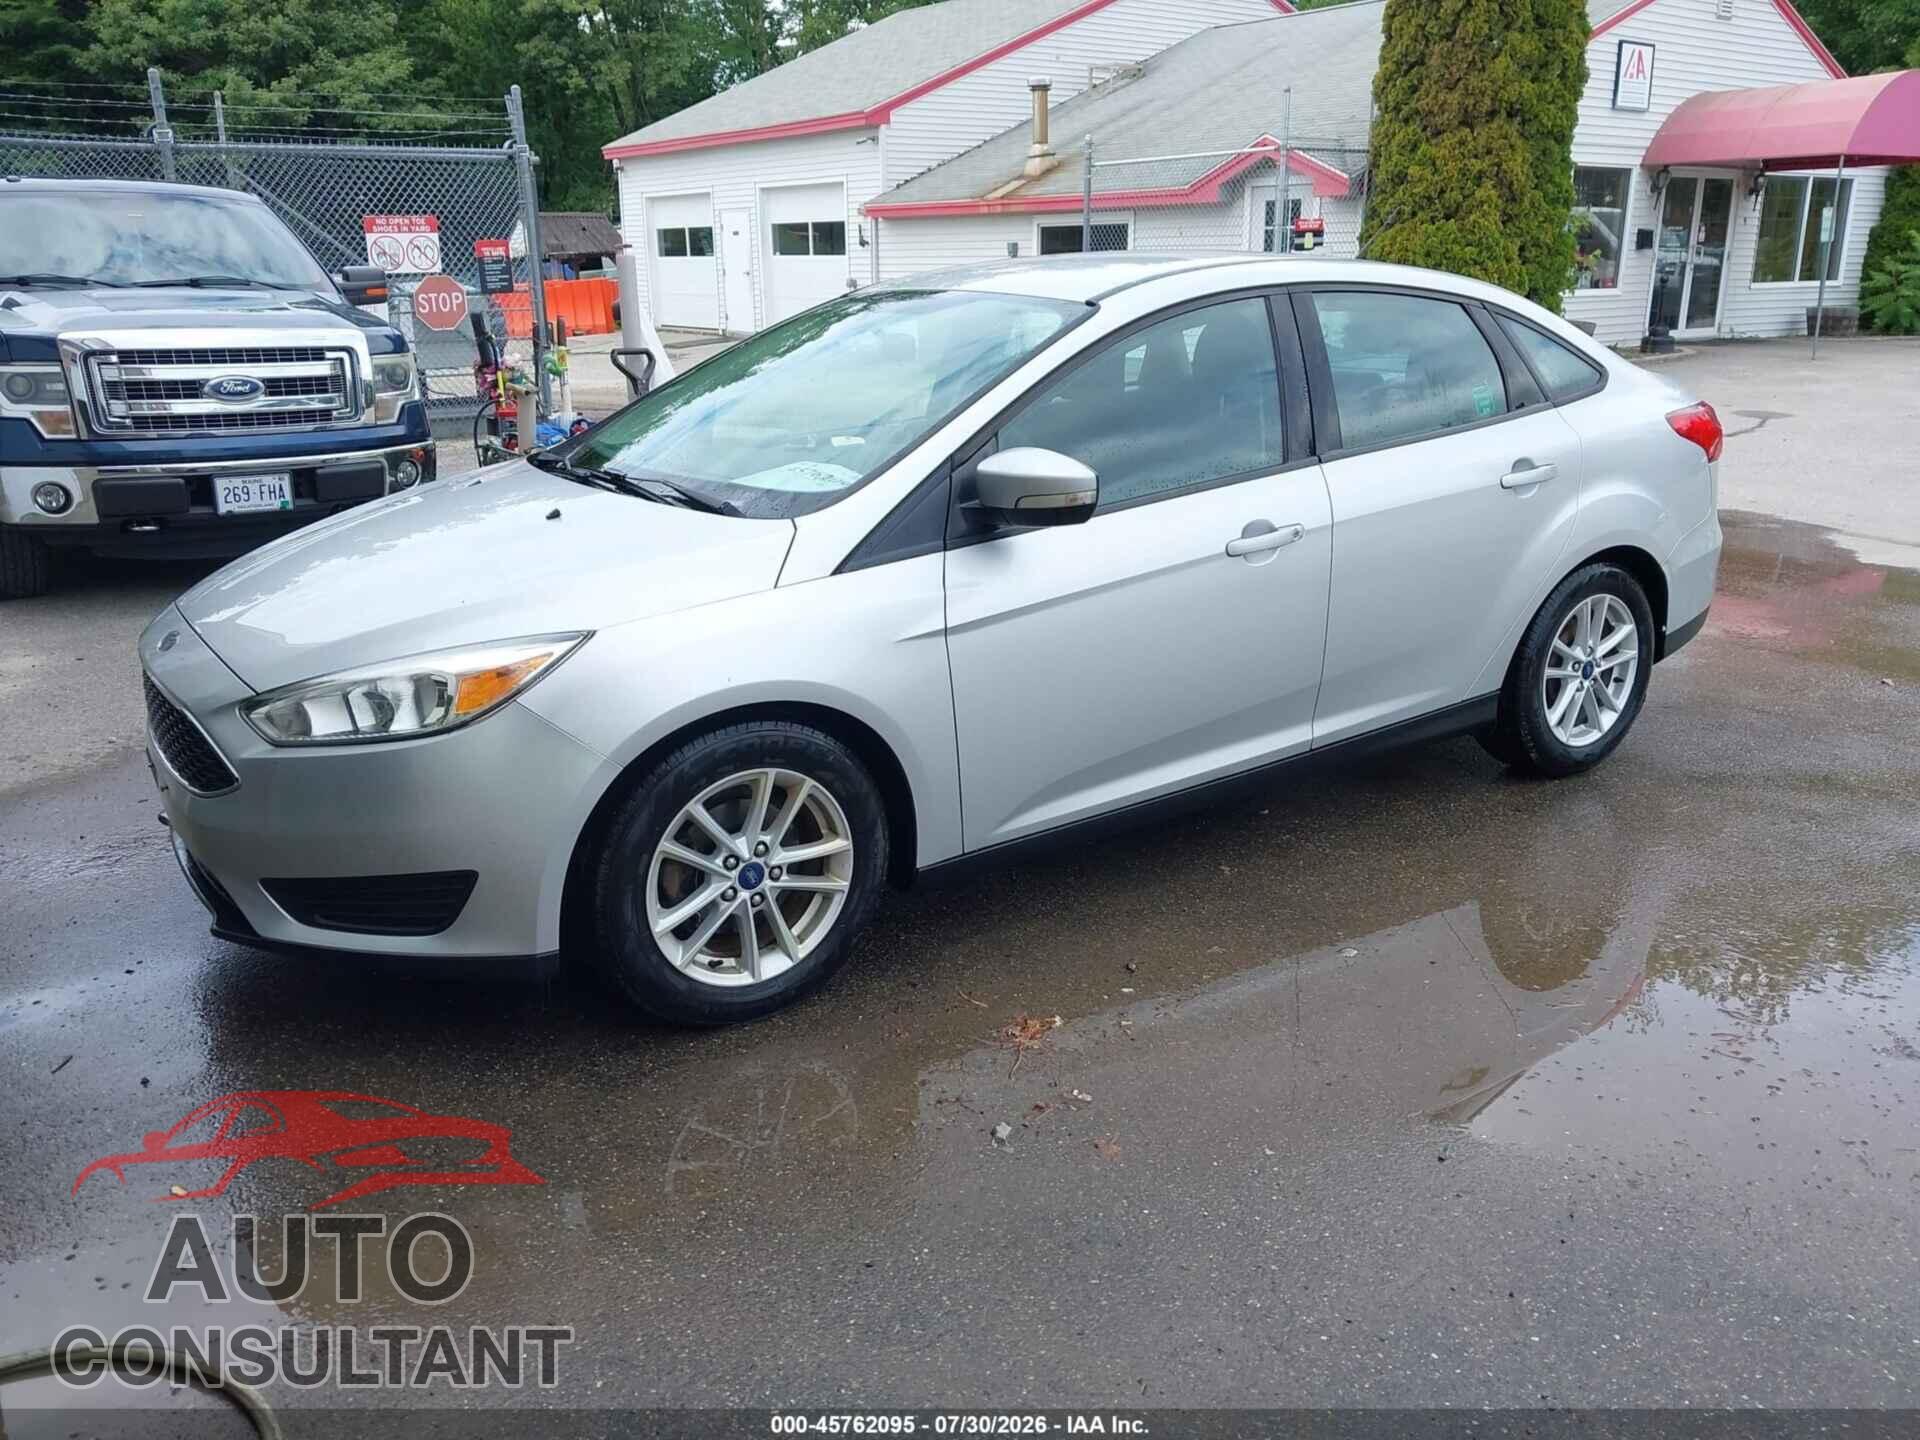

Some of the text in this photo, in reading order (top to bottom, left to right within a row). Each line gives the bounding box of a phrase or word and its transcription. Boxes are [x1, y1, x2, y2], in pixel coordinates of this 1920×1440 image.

[372, 225, 431, 233] SHOES IN YARD
[418, 292, 463, 313] STOP
[220, 380, 251, 394] Ford
